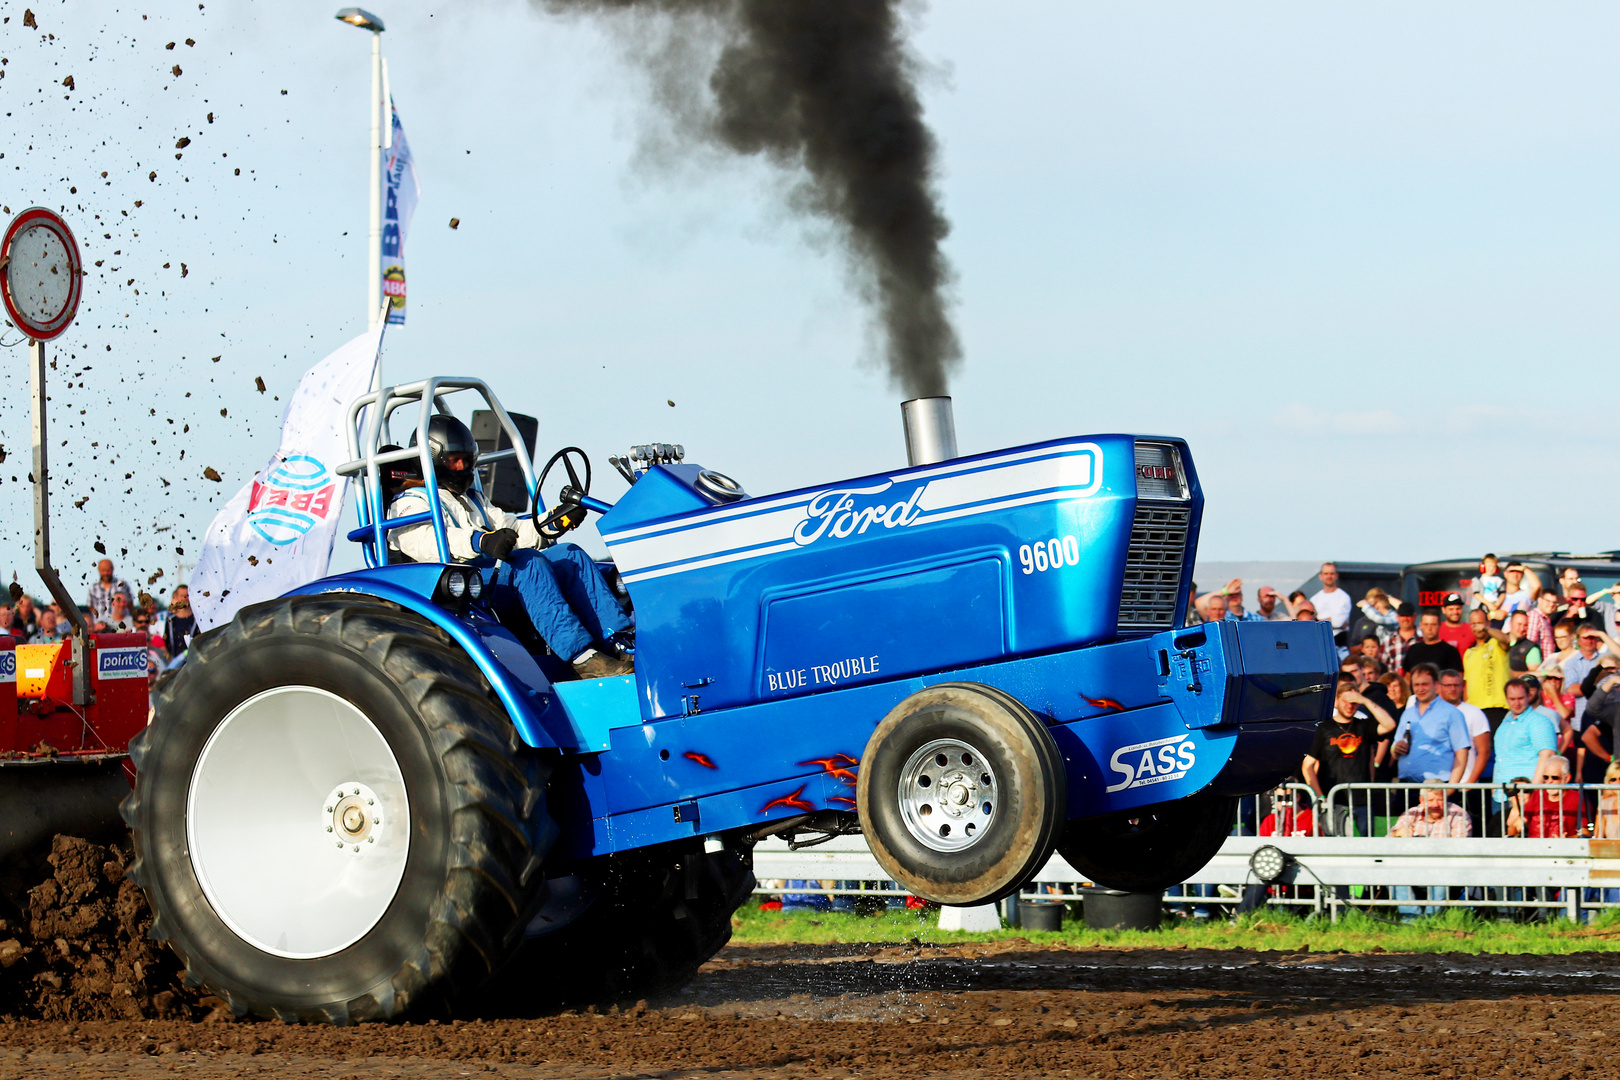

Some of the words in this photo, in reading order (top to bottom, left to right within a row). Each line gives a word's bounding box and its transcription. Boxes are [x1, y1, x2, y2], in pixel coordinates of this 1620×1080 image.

[794, 480, 926, 546] Ford
[1019, 535, 1080, 575] 9600
[103, 654, 134, 670] point
[138, 652, 148, 671] S
[768, 669, 807, 691] BLUE
[811, 655, 880, 685] TROUBLE
[1106, 734, 1196, 793] SASS
